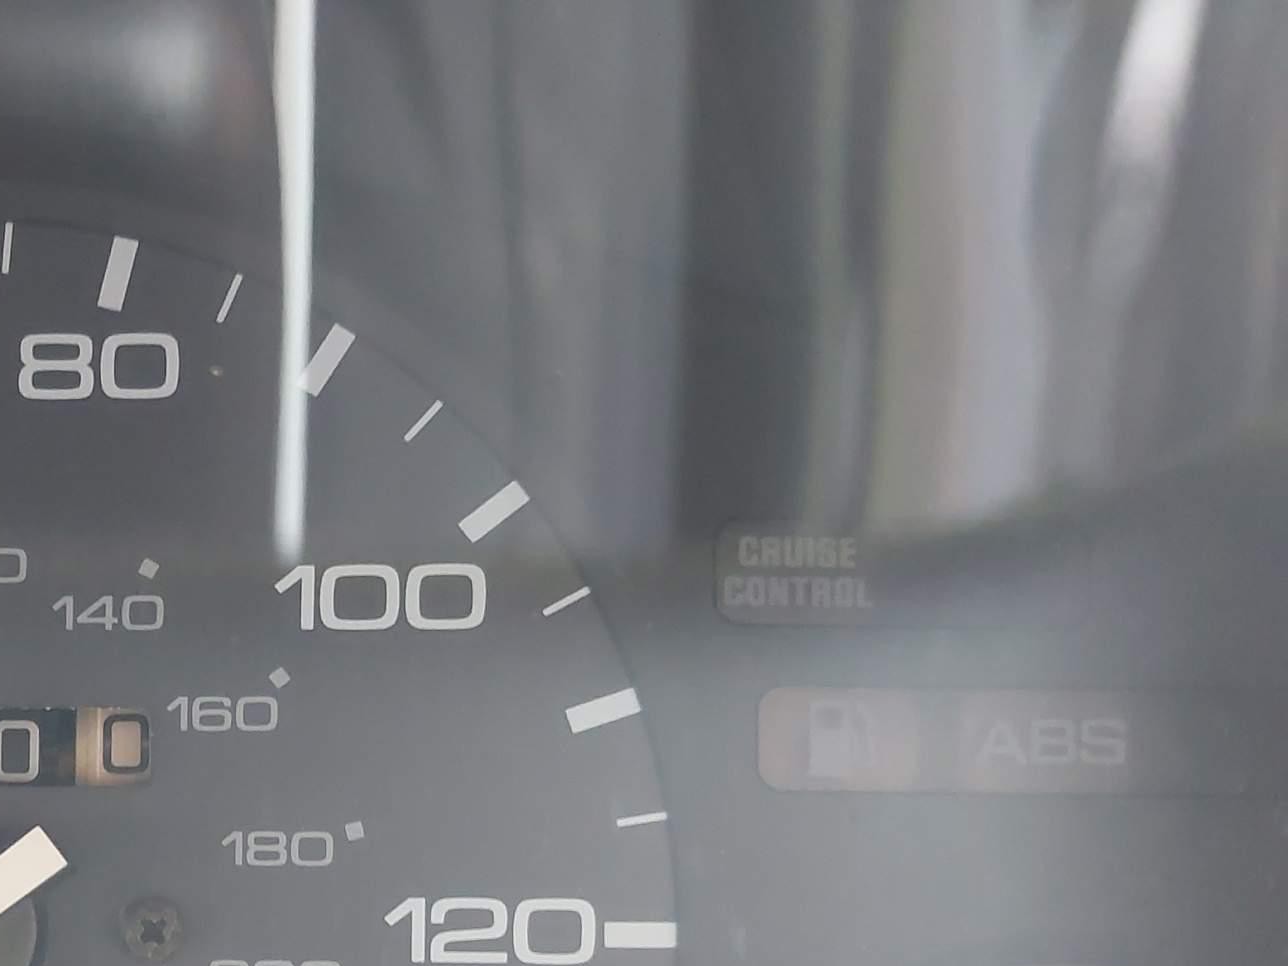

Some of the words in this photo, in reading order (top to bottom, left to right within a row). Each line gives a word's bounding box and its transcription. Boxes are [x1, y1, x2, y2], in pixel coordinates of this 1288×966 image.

[19, 333, 179, 399] 80
[738, 535, 857, 569] CRUISE
[275, 563, 486, 630] 100
[722, 575, 873, 608] CONTROL
[53, 595, 164, 630] 140
[167, 696, 278, 731] 160
[977, 717, 1129, 766] ABS
[222, 831, 333, 866] 180
[385, 898, 596, 964] 120
